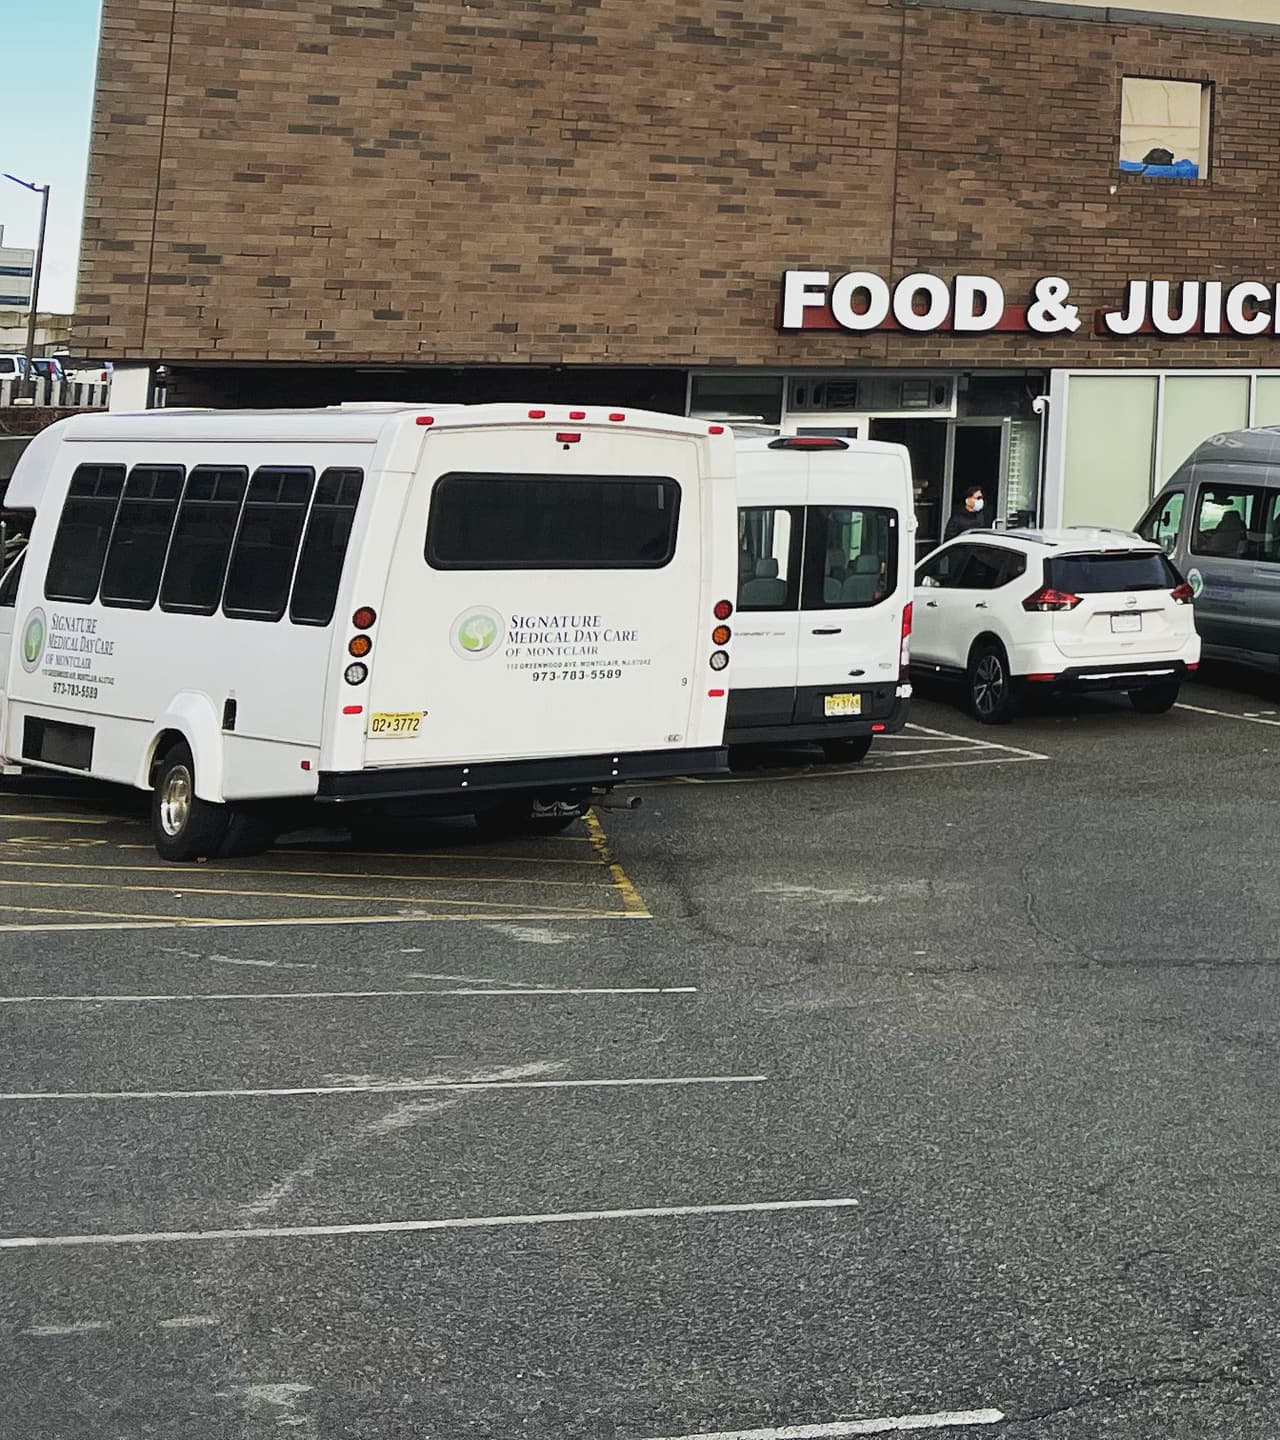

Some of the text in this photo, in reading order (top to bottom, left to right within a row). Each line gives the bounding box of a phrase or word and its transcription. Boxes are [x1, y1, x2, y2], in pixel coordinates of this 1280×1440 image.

[783, 270, 1005, 332] FOOD
[1026, 276, 1081, 333] &
[51, 613, 98, 633] SIGNATURE
[510, 615, 603, 628] SIGNATURE
[507, 629, 639, 644] MEDICAL DAY CARE
[505, 646, 599, 657] OF MONTCLAIR
[532, 669, 622, 682] 973-783-5589
